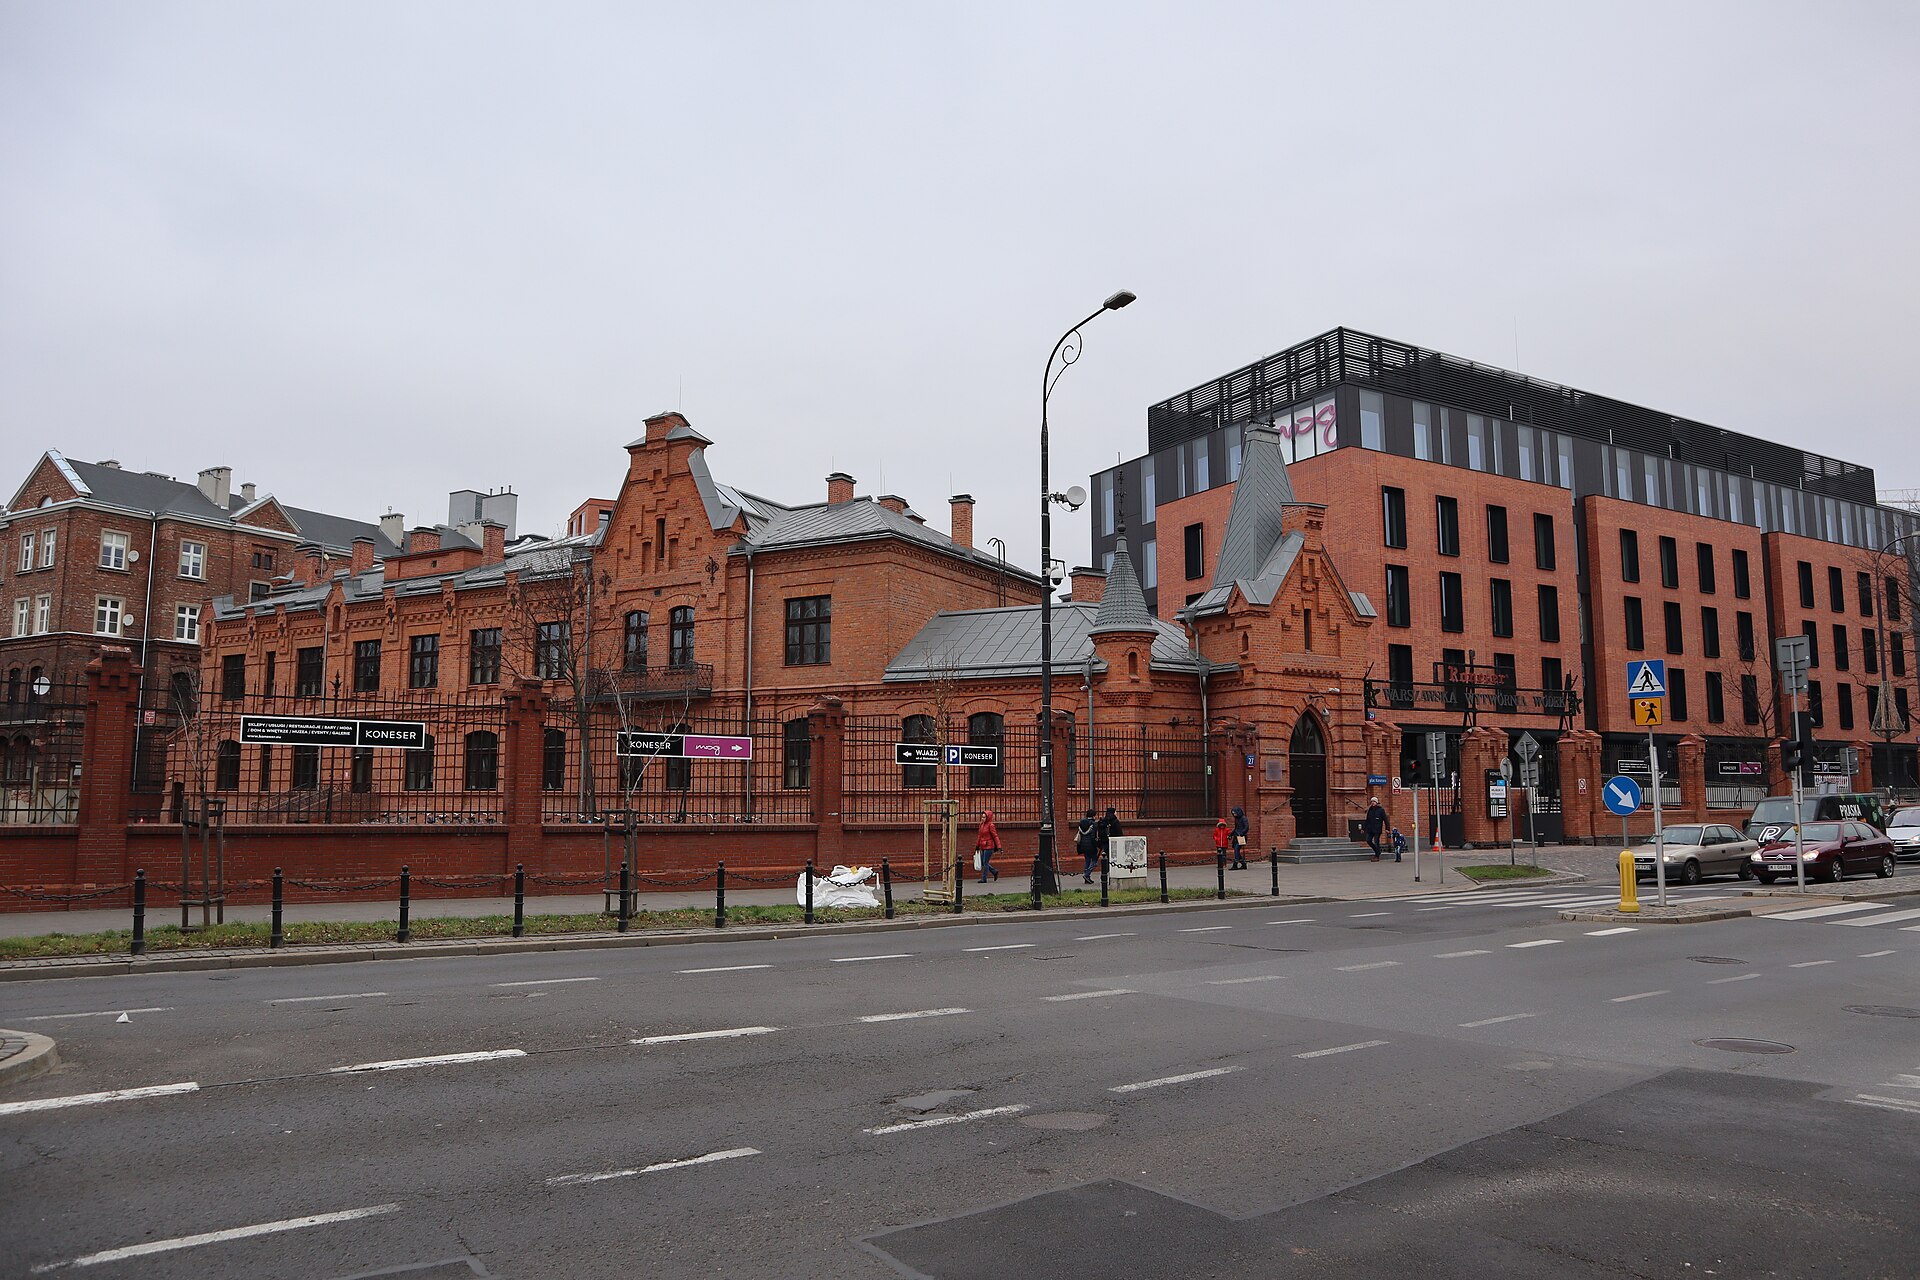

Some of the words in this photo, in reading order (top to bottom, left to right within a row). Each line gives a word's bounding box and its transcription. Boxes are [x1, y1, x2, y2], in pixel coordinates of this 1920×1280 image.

[365, 730, 416, 740] KONESER
[630, 741, 671, 750] KONESER
[950, 749, 958, 762] P
[1839, 804, 1862, 817] PRASKA
